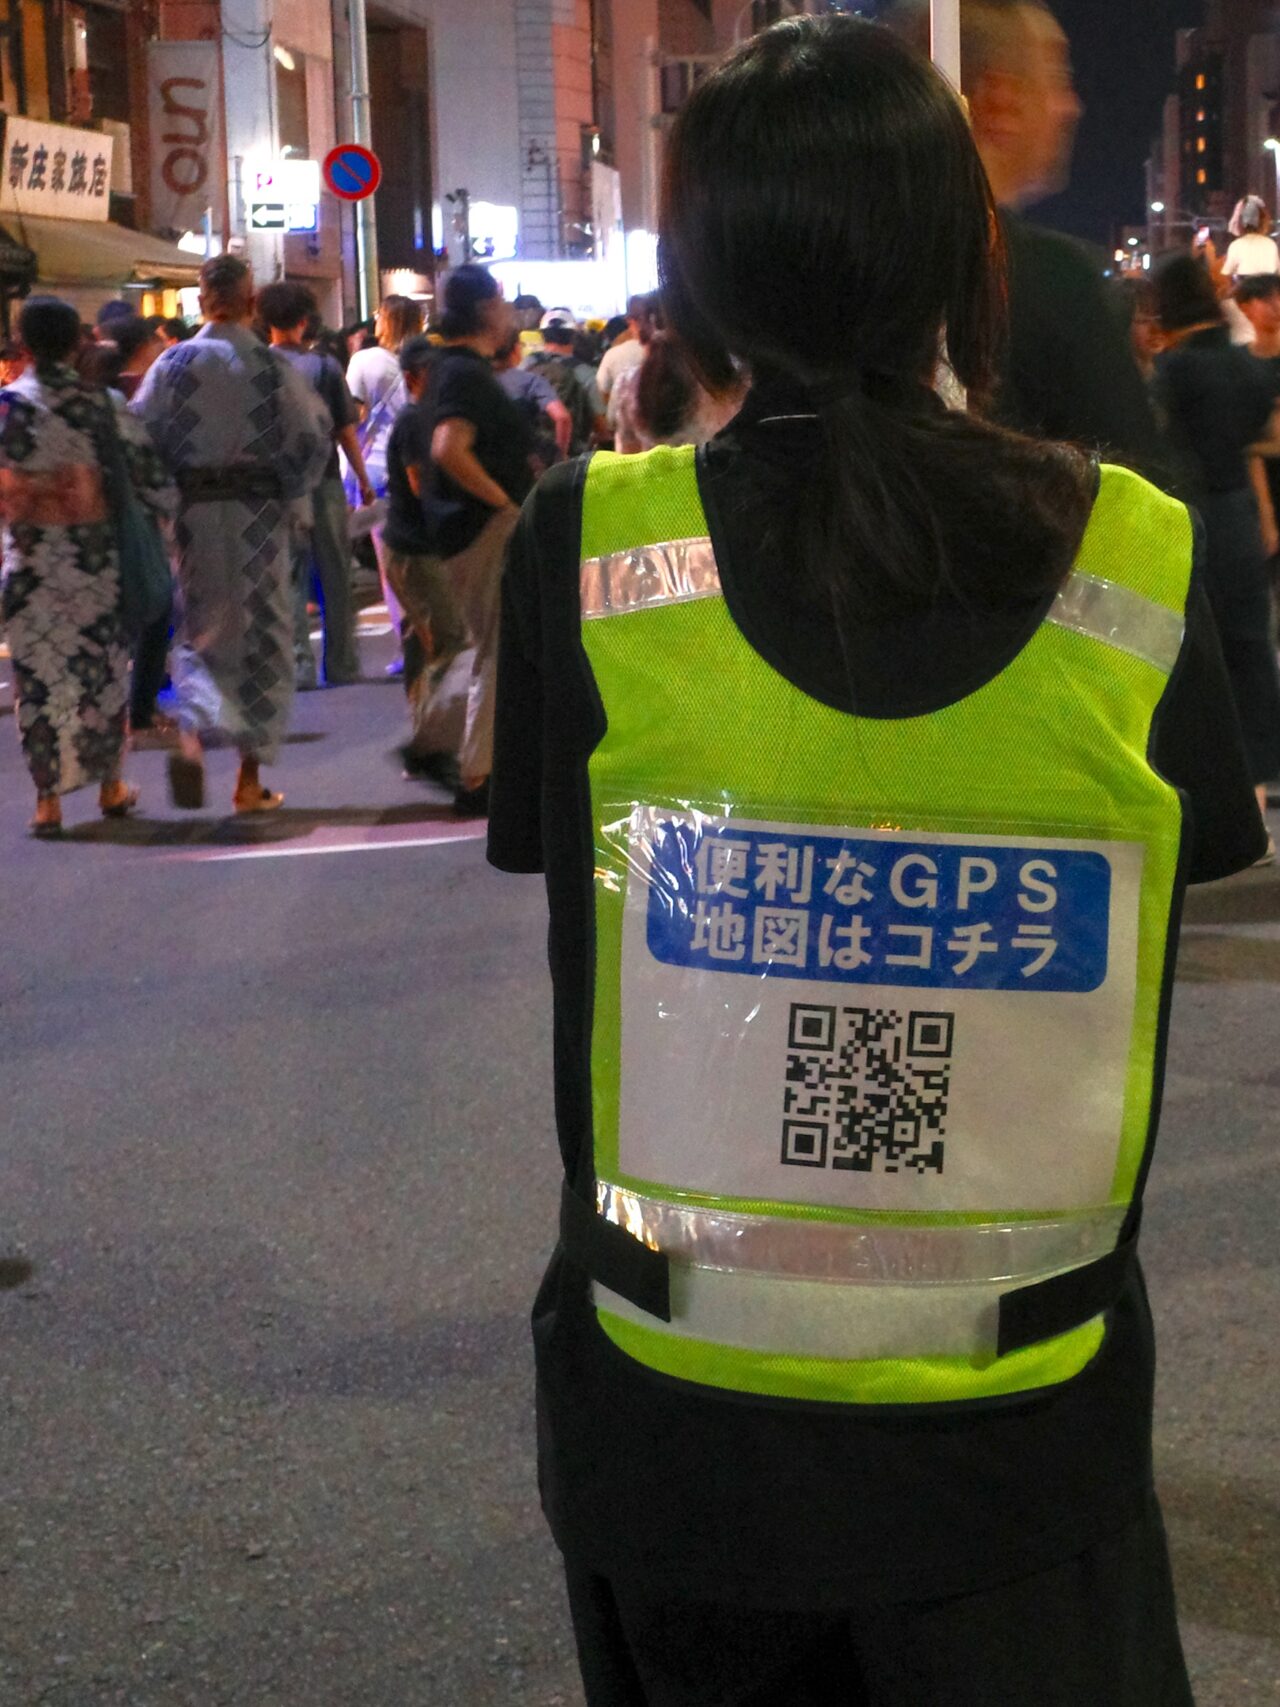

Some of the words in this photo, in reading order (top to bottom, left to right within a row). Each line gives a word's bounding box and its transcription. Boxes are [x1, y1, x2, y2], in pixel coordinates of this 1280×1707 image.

[689, 903, 1060, 978] 地図はコチラ
